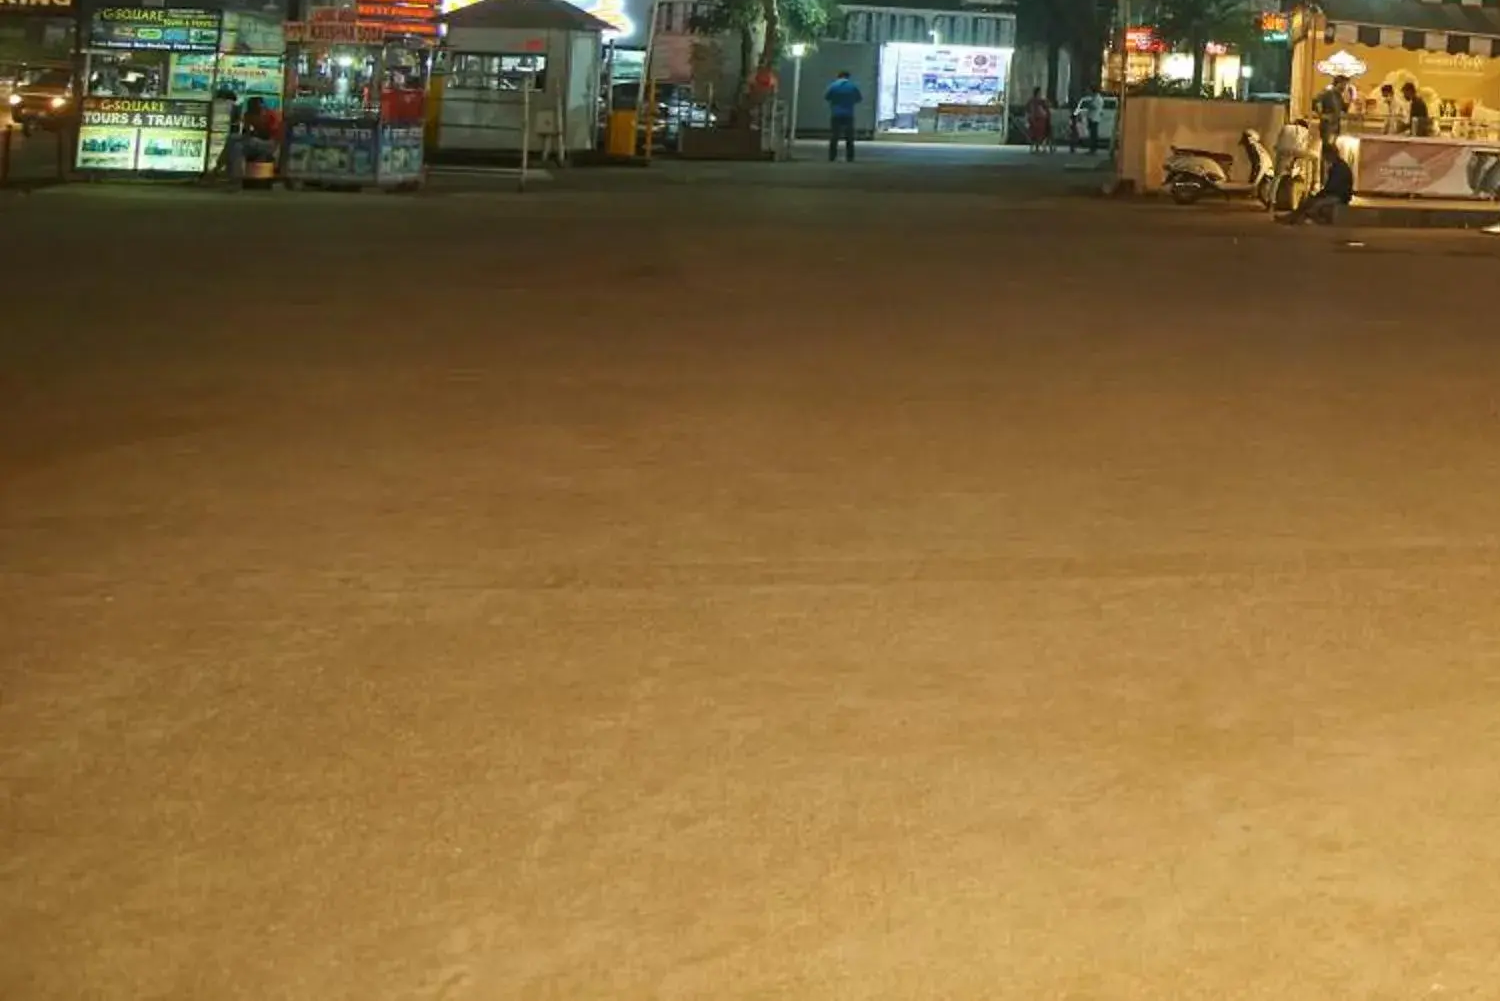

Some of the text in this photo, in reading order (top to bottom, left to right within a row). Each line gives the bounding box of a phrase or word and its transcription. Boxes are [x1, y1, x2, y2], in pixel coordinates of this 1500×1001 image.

[102, 7, 164, 21] G-SQUARE
[83, 111, 208, 128] TOURS & TRAVELS
